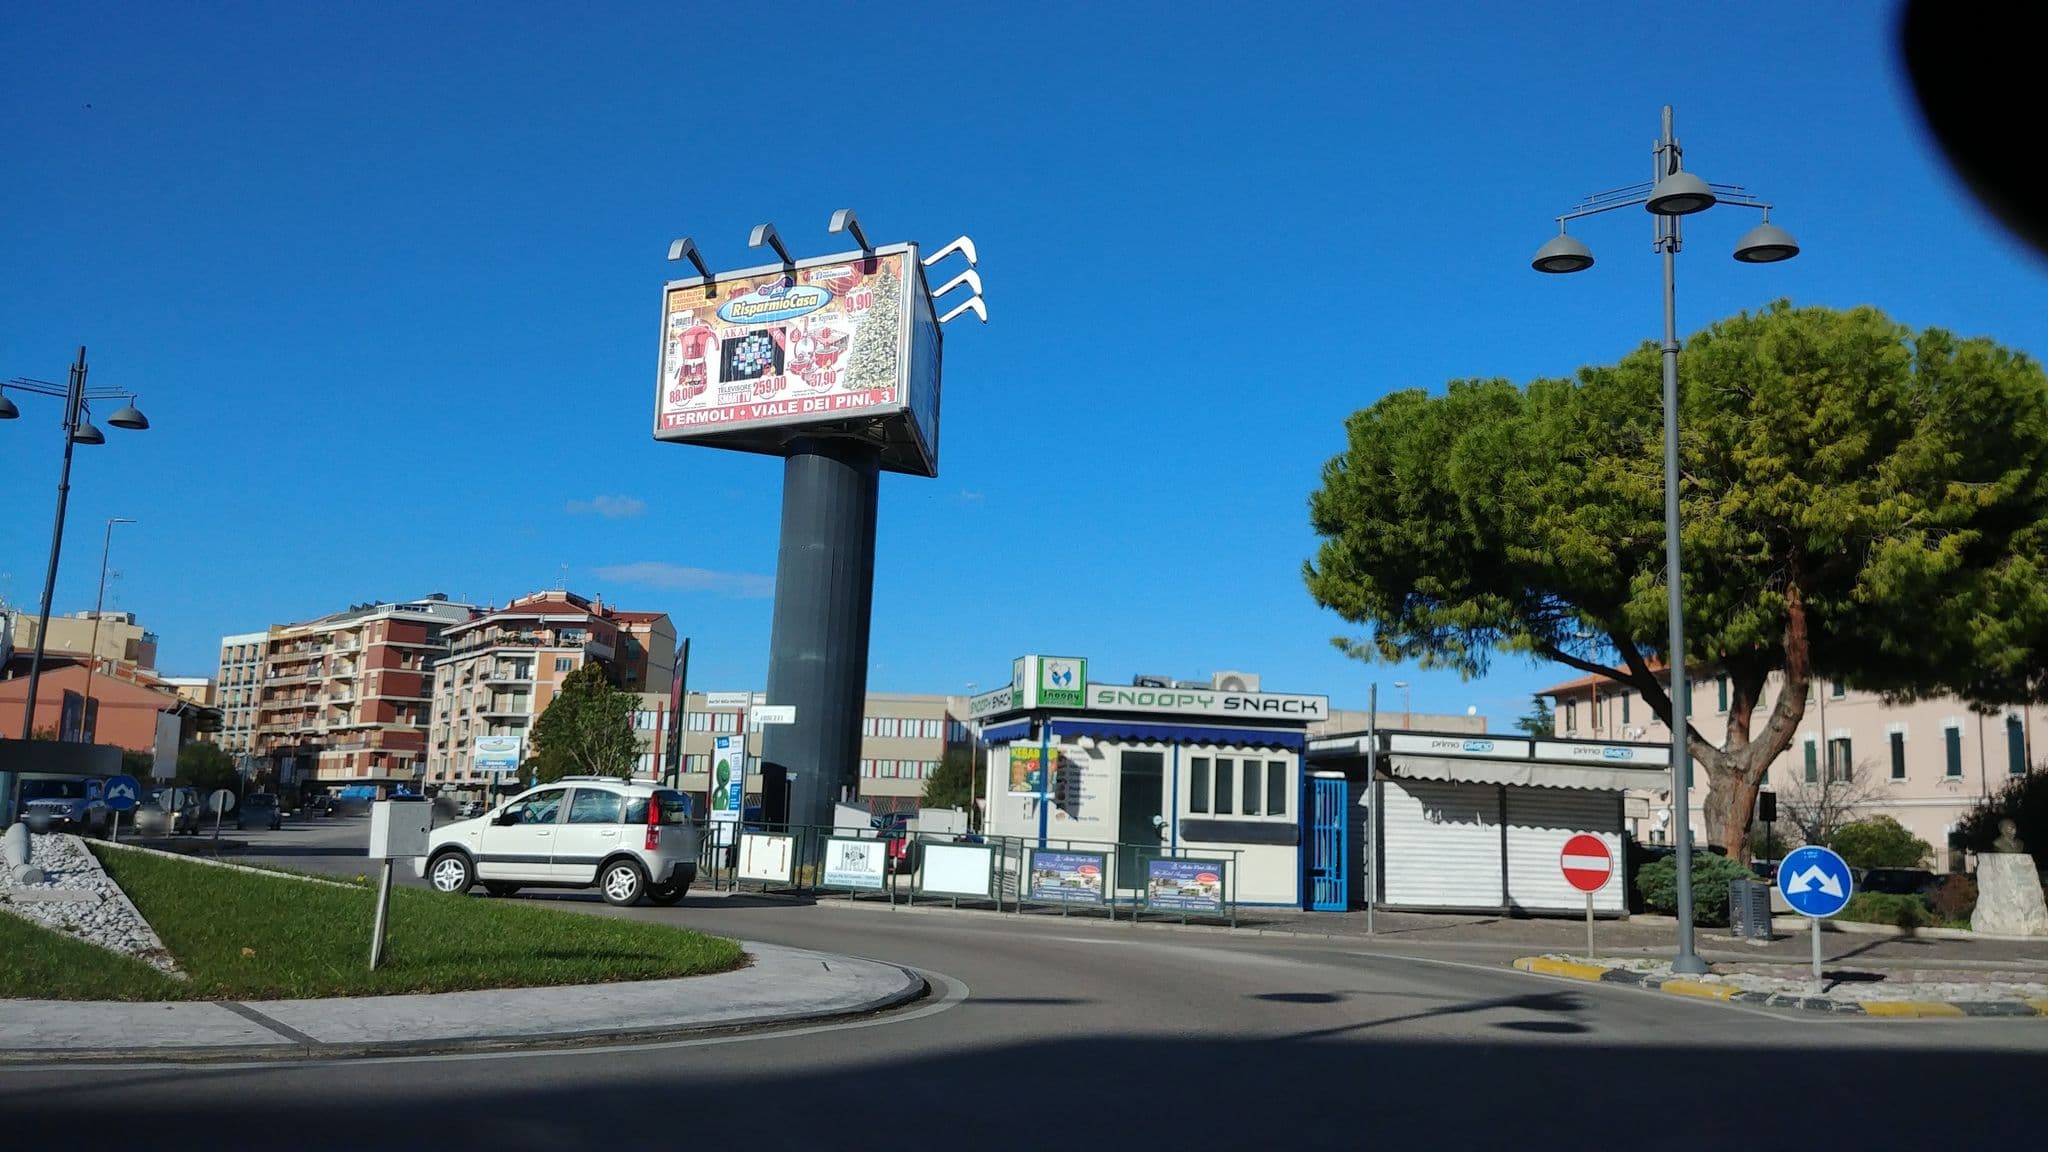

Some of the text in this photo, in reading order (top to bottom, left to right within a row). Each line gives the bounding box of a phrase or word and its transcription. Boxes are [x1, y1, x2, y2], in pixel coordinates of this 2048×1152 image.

[731, 294, 819, 317] RisparmioCasa
[846, 292, 872, 313] 9,90
[723, 327, 748, 338] AKAI
[752, 376, 787, 397] 259,00
[667, 408, 736, 426] TERMOLI
[752, 401, 799, 417] VIALE
[803, 398, 831, 412] DEI
[881, 391, 891, 403] 3
[1097, 690, 1318, 714] SNOOPY SNACK
[1431, 740, 1460, 750] primo
[1573, 747, 1601, 755] primo
